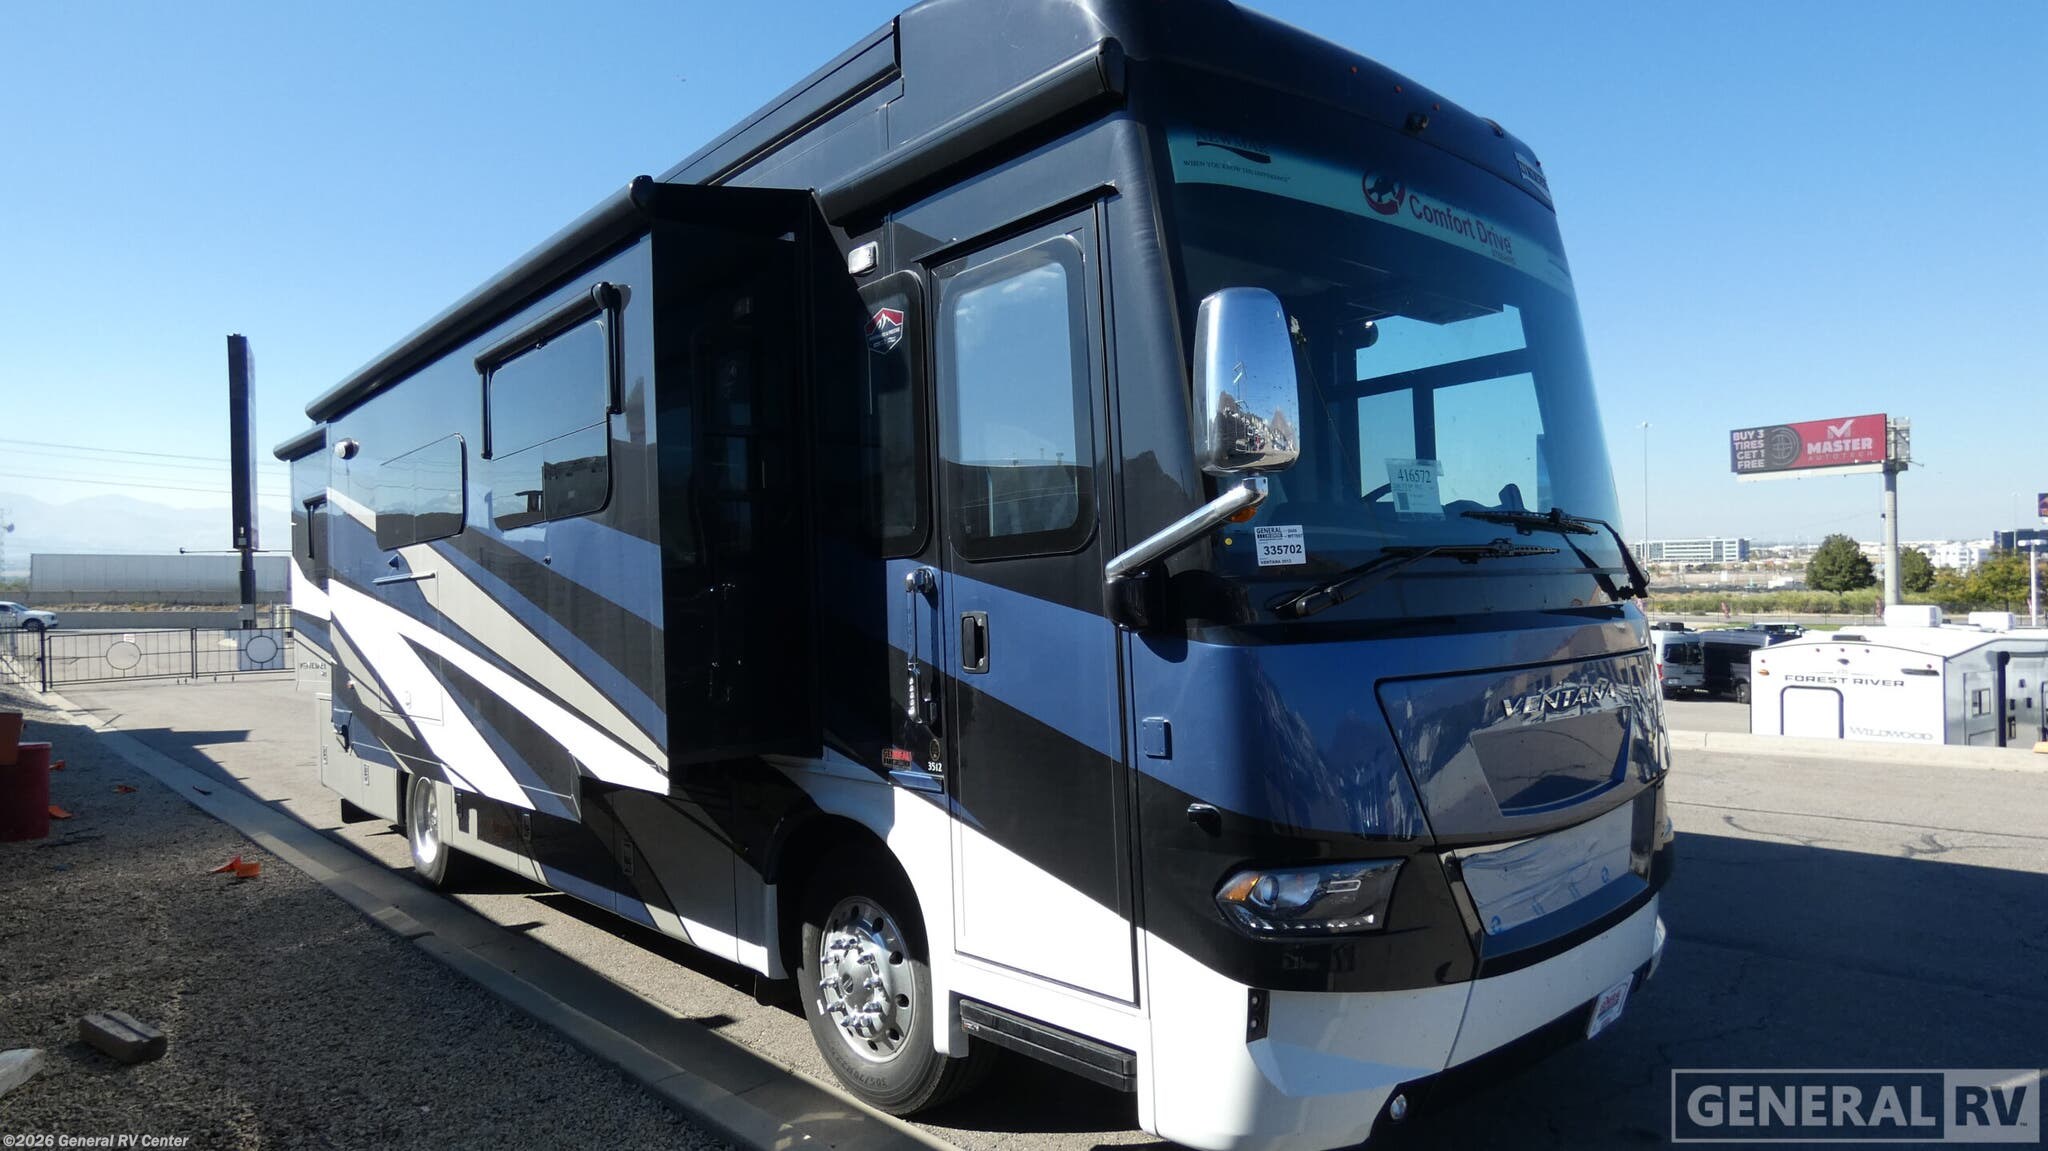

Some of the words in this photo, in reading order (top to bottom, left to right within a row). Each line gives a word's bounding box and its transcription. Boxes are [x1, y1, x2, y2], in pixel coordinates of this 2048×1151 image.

[1409, 194, 1475, 240] Comfort
[1476, 220, 1513, 254] Drive
[1732, 430, 1755, 441] BUY
[1757, 429, 1764, 439] 3
[1733, 440, 1765, 450] TIRES
[1807, 437, 1873, 455] MASTER
[1736, 450, 1758, 460] GET
[1760, 449, 1765, 458] 1
[1737, 459, 1765, 469] FREE
[1397, 468, 1431, 483] 416572
[1263, 544, 1303, 556] 335702
[1784, 674, 1848, 684] FOREST
[1853, 678, 1905, 687] RIVER
[1502, 681, 1618, 717] VENTANA
[1849, 726, 1934, 741] WILDWOOD
[927, 761, 943, 772] 3512
